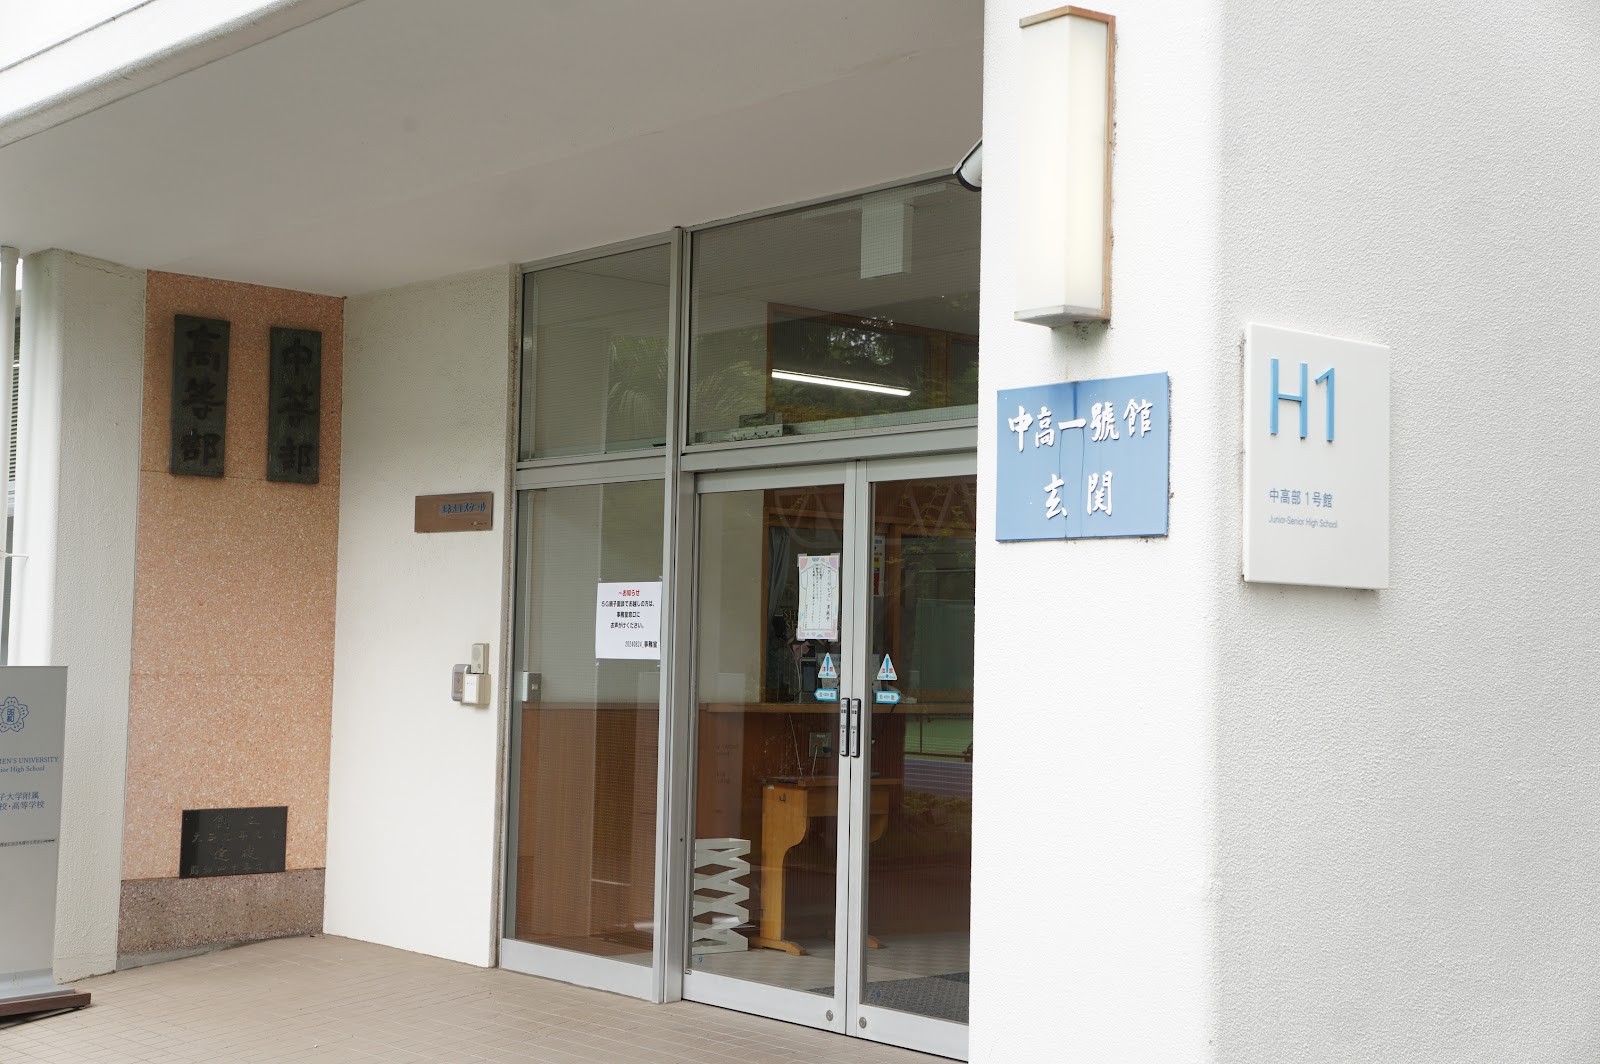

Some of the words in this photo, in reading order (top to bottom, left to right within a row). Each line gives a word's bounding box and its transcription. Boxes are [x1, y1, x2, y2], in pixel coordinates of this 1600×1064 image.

[1270, 358, 1335, 442] H1
[1008, 398, 1154, 452] 中高一號館
[1044, 471, 1113, 520] 玄関
[1268, 514, 1305, 526] Junior-Senior
[1305, 517, 1319, 529] High
[1319, 518, 1338, 529] School
[10, 765, 25, 774] High
[25, 764, 45, 772] School
[18, 756, 59, 764] UNIVERSITY
